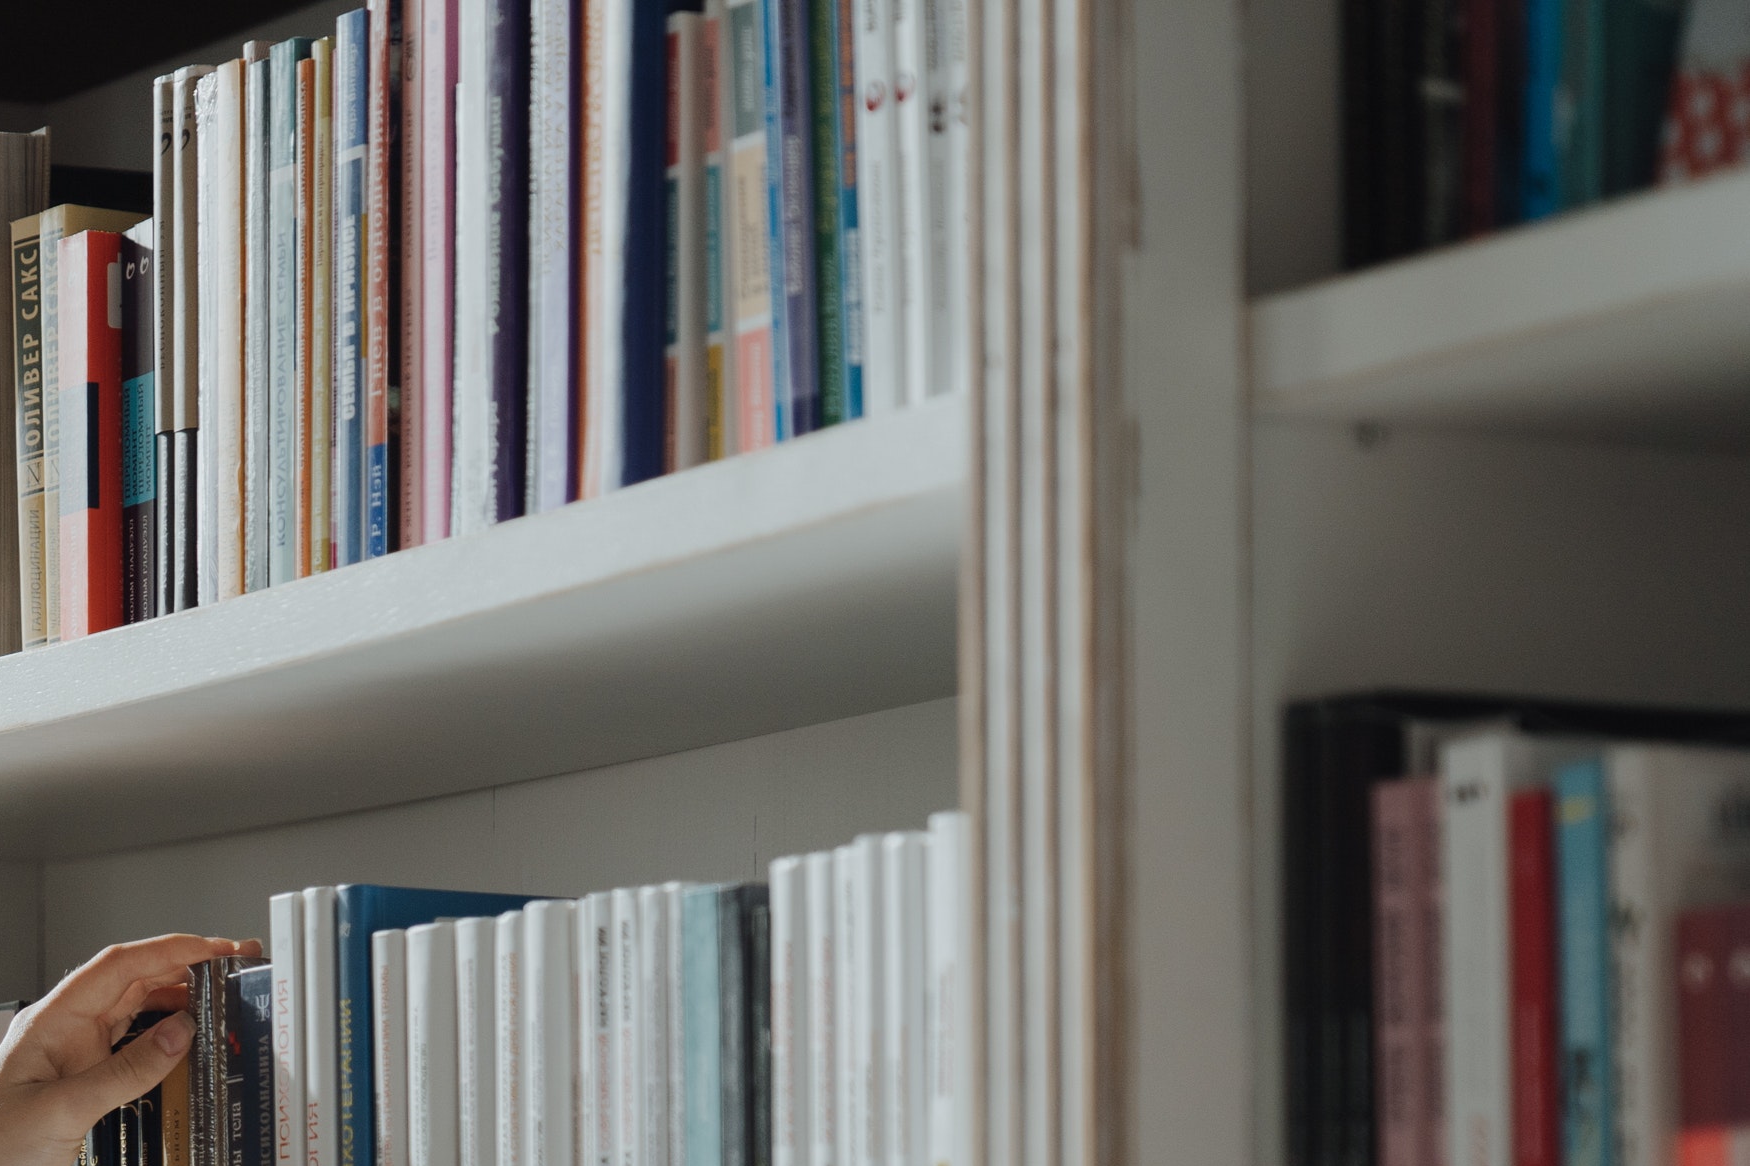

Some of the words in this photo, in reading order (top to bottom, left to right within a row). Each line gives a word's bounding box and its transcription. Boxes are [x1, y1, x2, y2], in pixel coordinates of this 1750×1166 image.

[20, 249, 38, 319] САКС
[276, 231, 287, 304] СЕМЬИ
[341, 213, 356, 312] КРИЗИСЕ
[372, 296, 382, 313] в
[22, 333, 40, 446] ОЛИВЕР
[371, 325, 382, 396] Гнев
[276, 314, 287, 547] КОНСУЛЬТИРОВАНИЕ
[371, 464, 382, 507] Нэй
[29, 510, 42, 632] ГАЛЛЮЦИНАЦИИ
[277, 979, 291, 1160] ПСИХОЛОГИЯ
[118, 1123, 127, 1154] себя
[231, 1102, 242, 1141] тела
